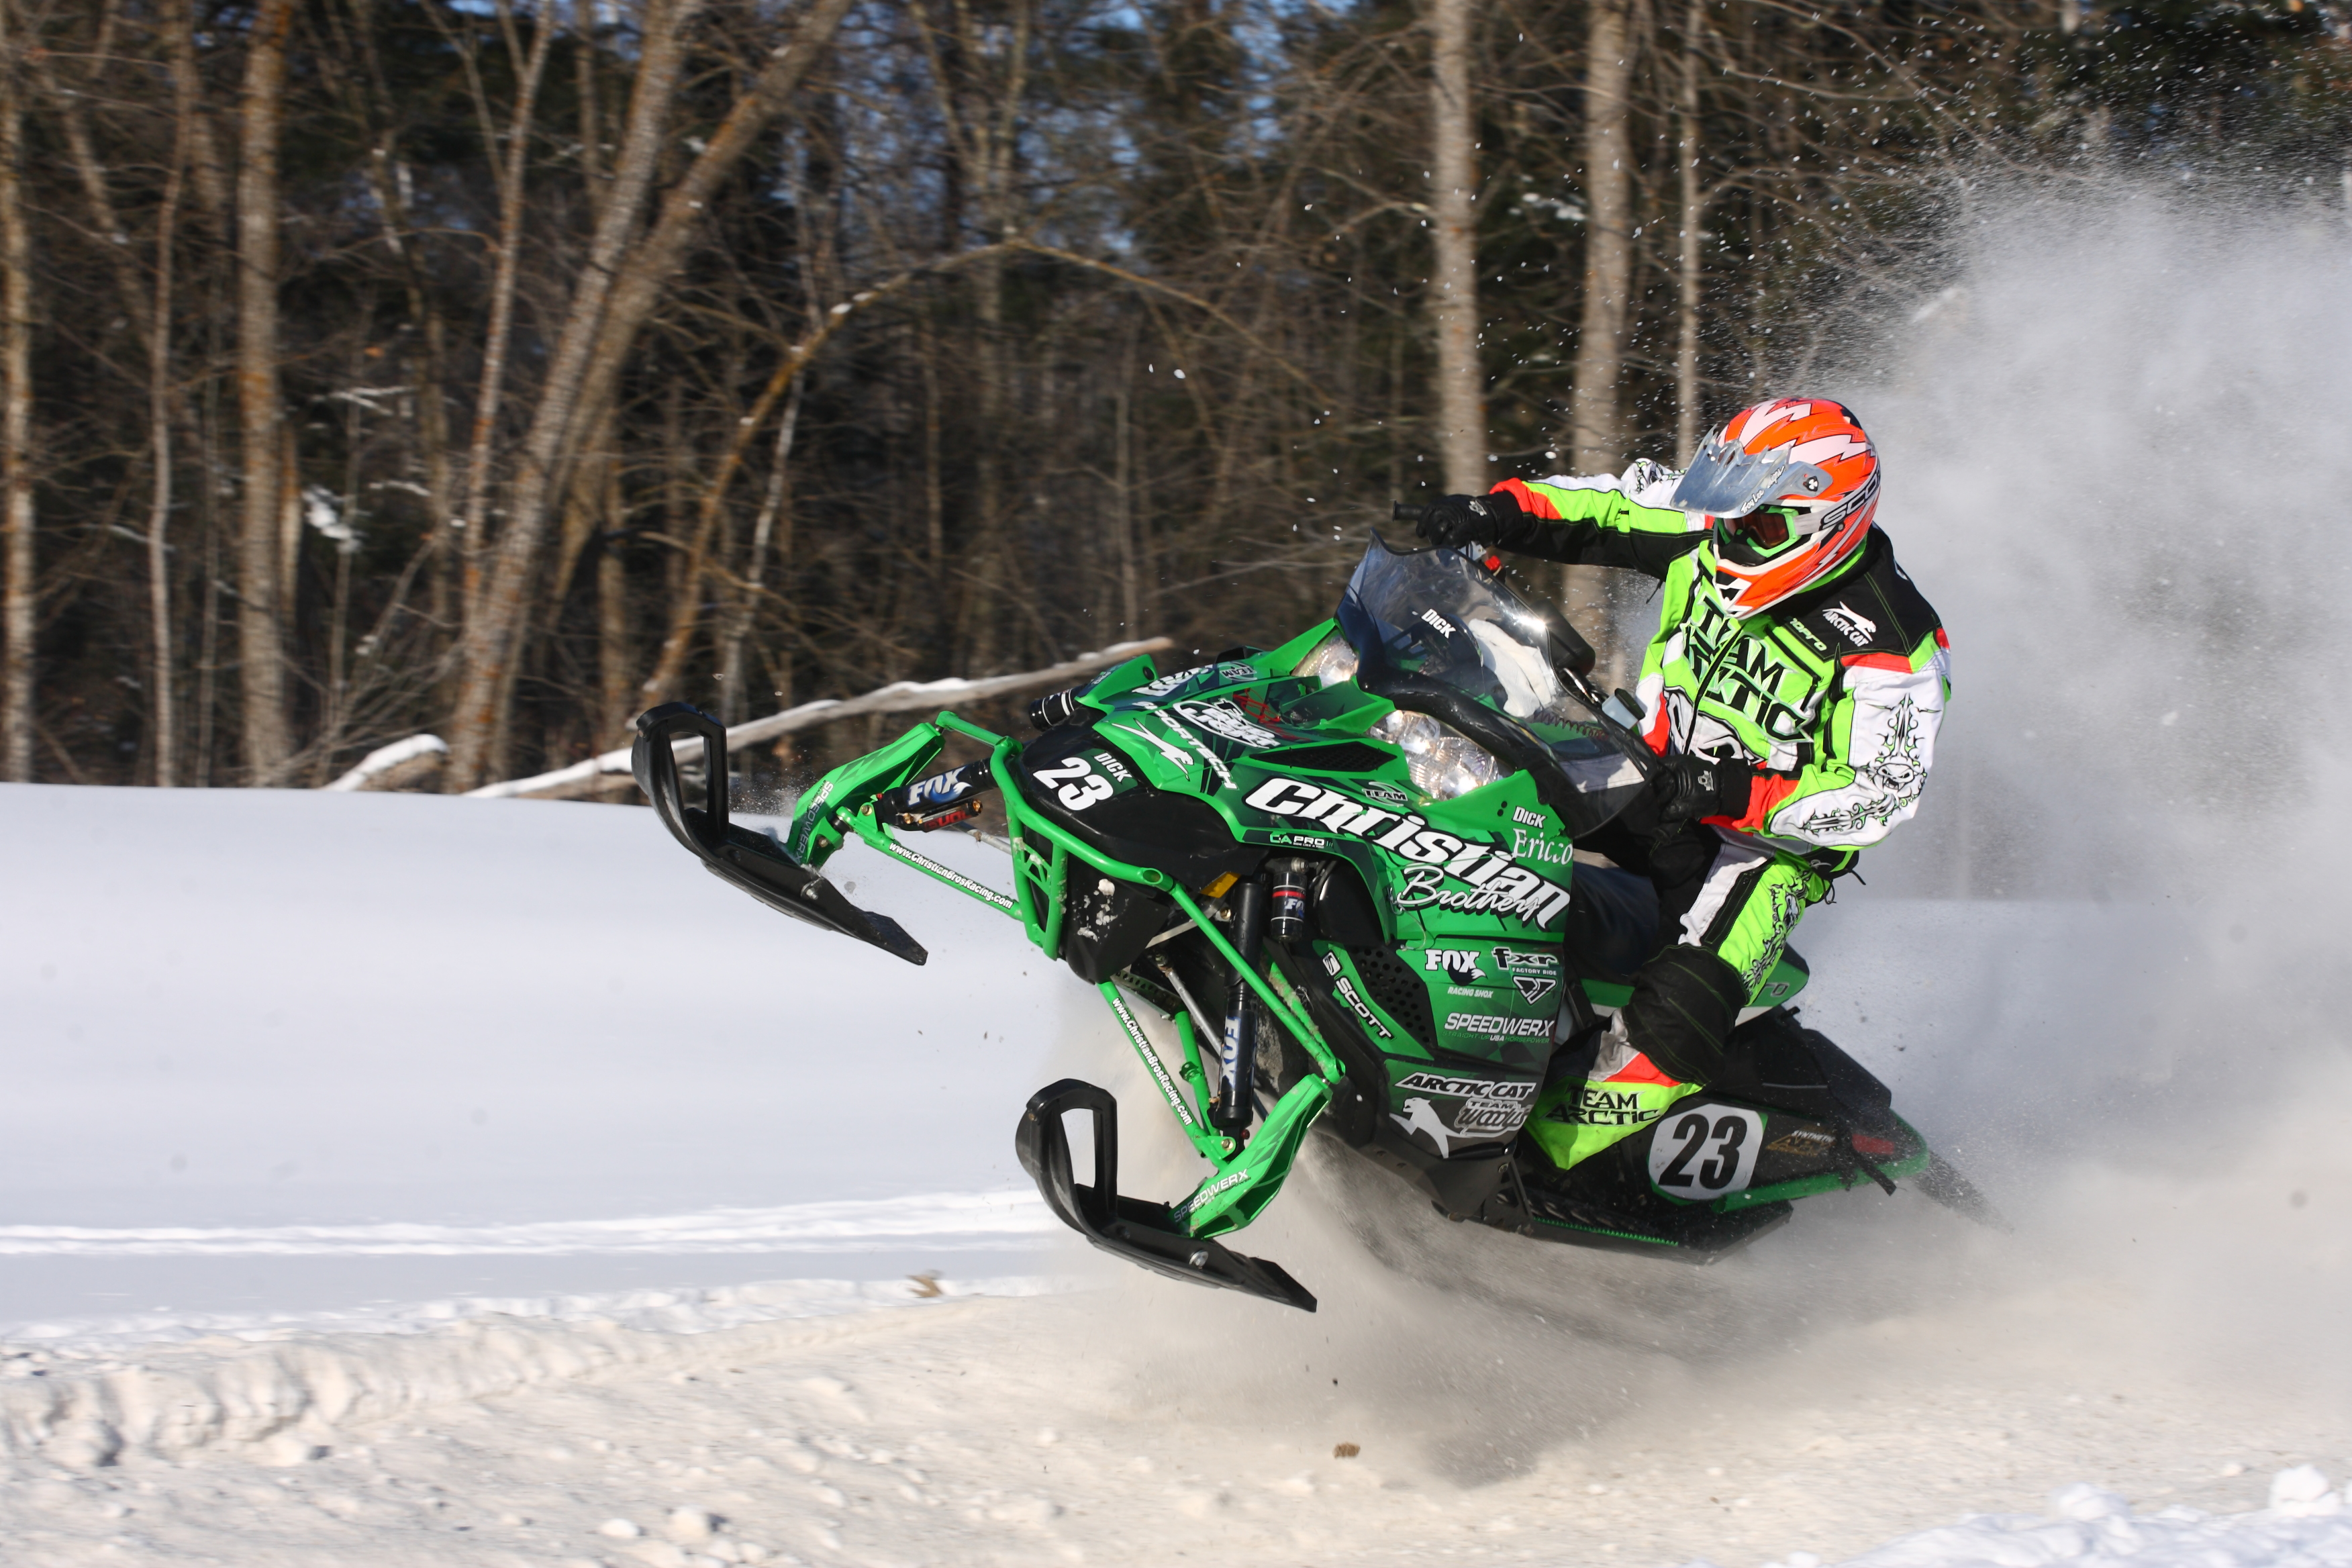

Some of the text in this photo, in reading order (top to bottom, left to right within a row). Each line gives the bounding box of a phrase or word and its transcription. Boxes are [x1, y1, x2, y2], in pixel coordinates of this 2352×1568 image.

[1751, 489, 1765, 503] Lee
[1822, 473, 1880, 530] SCO
[1420, 607, 1457, 640] DICK
[1822, 610, 1869, 647] ARCTIC CAT
[1220, 665, 1257, 679] TEAM
[1132, 701, 1238, 790] SPORTECH
[908, 765, 967, 805] FOX
[1033, 756, 1116, 811] 23
[1093, 752, 1133, 783] DICK
[1363, 788, 1408, 801] TEAM
[795, 781, 834, 864] SPEEDWERX
[1512, 805, 1547, 828] DICK
[1245, 777, 1571, 930] Christian
[1293, 836, 1325, 846] PRO
[888, 841, 1014, 910] www.ChristianBrosRacing.com
[1395, 865, 1541, 920] Brothers
[1425, 948, 1481, 973] FOX
[1336, 977, 1391, 1038] SCOTT
[1447, 987, 1493, 999] RACING SHOX
[1444, 1012, 1555, 1037] SPEEDWERX
[1112, 997, 1193, 1126] www.ChristianBrosRacing.com
[1220, 1016, 1240, 1088] FOX
[1400, 1074, 1534, 1099] ARCTIC CAT
[1565, 1084, 1639, 1110] TEAM
[1545, 1103, 1661, 1125] ARCTIC
[1658, 1112, 1748, 1191] 23
[1173, 1168, 1248, 1222] SPEEDWERX
